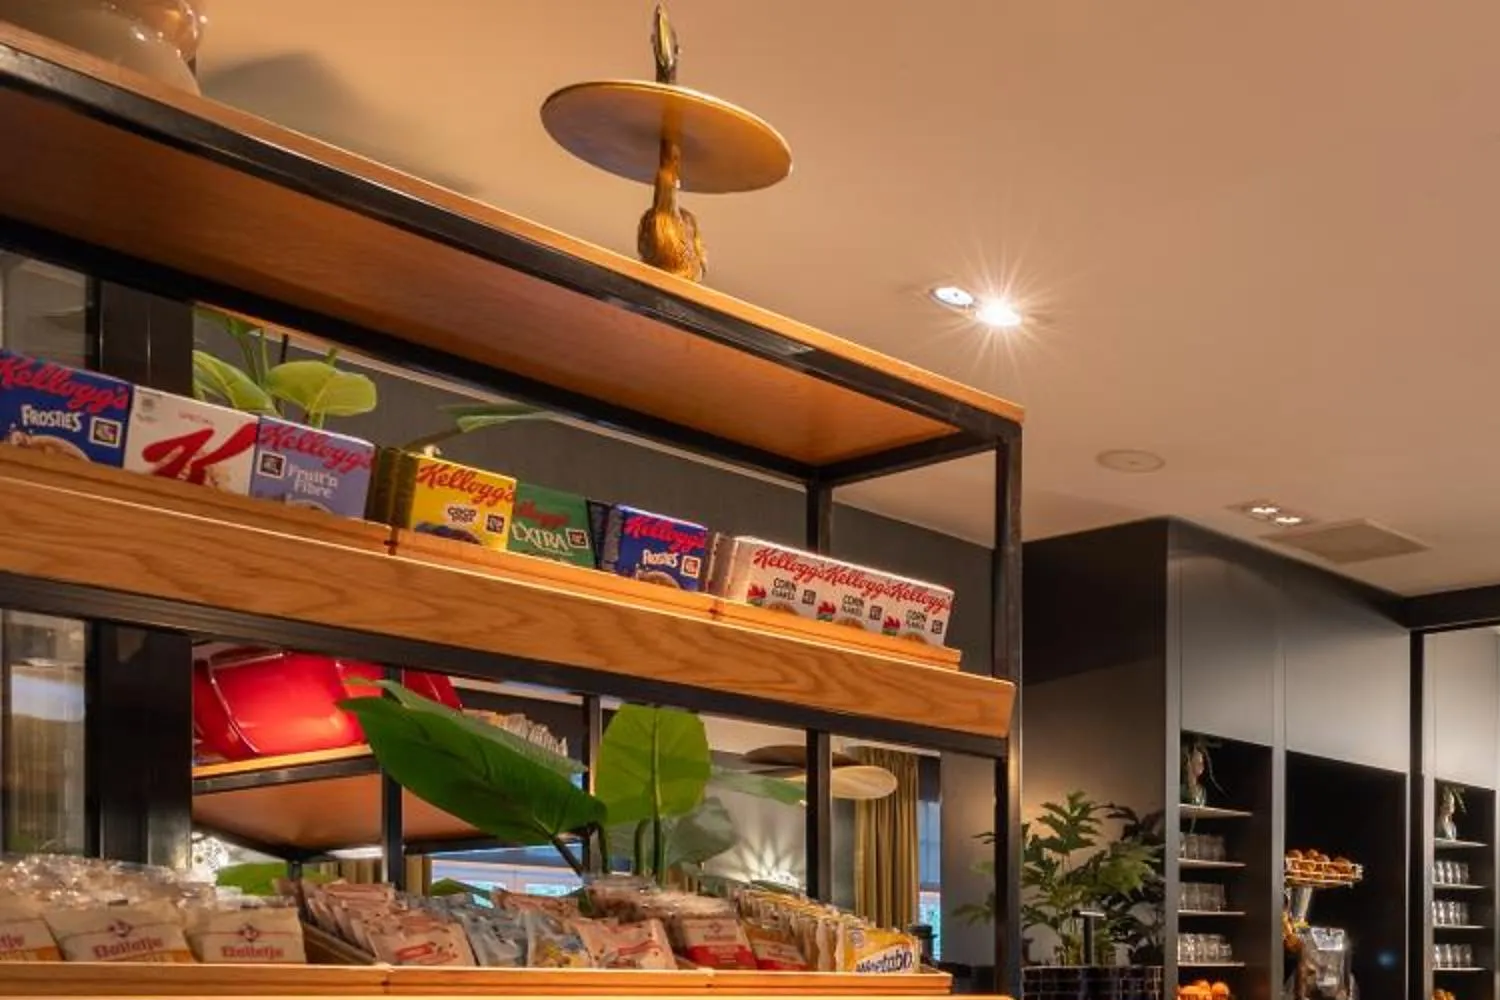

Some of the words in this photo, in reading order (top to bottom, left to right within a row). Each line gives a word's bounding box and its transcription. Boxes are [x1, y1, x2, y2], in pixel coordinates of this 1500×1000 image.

[260, 423, 373, 474] Kellogg's
[416, 463, 513, 506] Kellogg's
[754, 548, 825, 583] Kellogg's
[822, 563, 892, 599] Kellogg's
[773, 577, 797, 593] CORN
[843, 594, 865, 610] CORN
[905, 609, 928, 624] CORN
